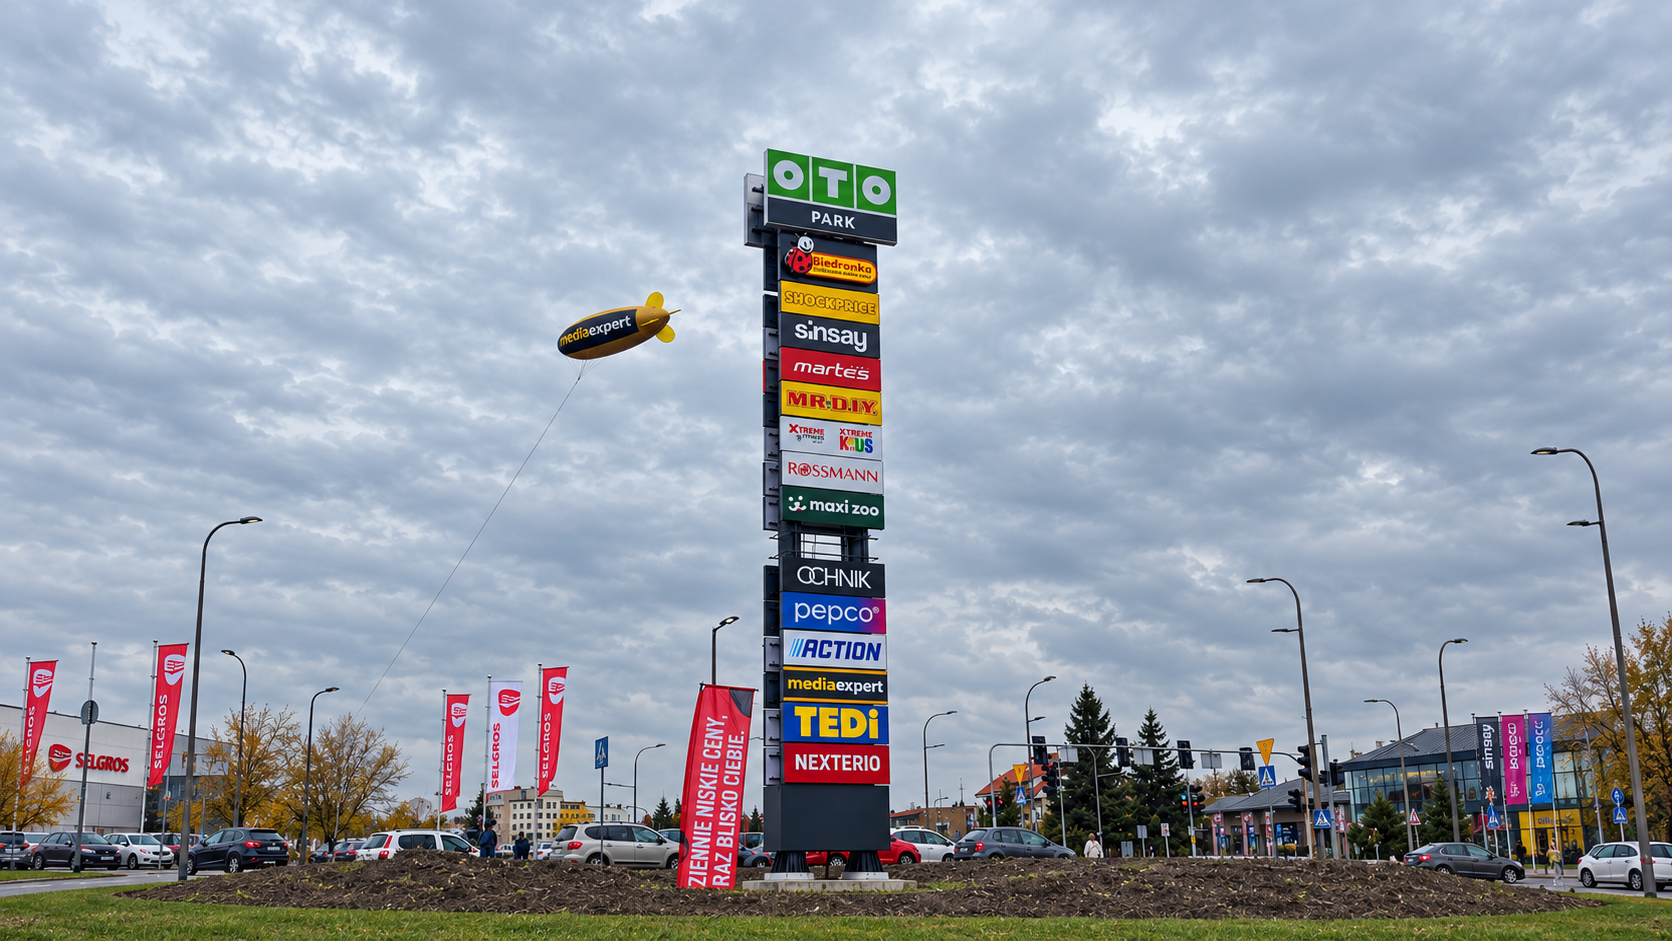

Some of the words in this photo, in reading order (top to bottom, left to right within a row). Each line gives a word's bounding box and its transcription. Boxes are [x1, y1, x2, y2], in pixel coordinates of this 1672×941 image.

[773, 160, 891, 206] OTO
[811, 210, 856, 230] PARK
[813, 256, 872, 274] Biedronka
[784, 290, 877, 315] SHOCKPRICE
[559, 315, 632, 347] mediaexpert
[794, 319, 867, 352] sinsay
[788, 462, 878, 483] ROSSMANN
[810, 499, 849, 514] maxi
[852, 505, 880, 517] zoo
[797, 565, 872, 589] OCHNIK
[801, 639, 882, 661] ACTION
[787, 677, 884, 695] mediaexpert
[153, 694, 168, 769] SELGROS
[702, 714, 728, 759] CENY,
[794, 706, 879, 739] TEDi
[491, 722, 501, 788] SELGROS
[723, 730, 745, 786] CIEBIE.
[795, 754, 881, 772] NEXTERIO
[695, 762, 719, 817] NISKIE
[715, 790, 738, 848] BLISKO
[688, 820, 713, 887] ZIENNIE
[712, 852, 733, 887] RAZ
